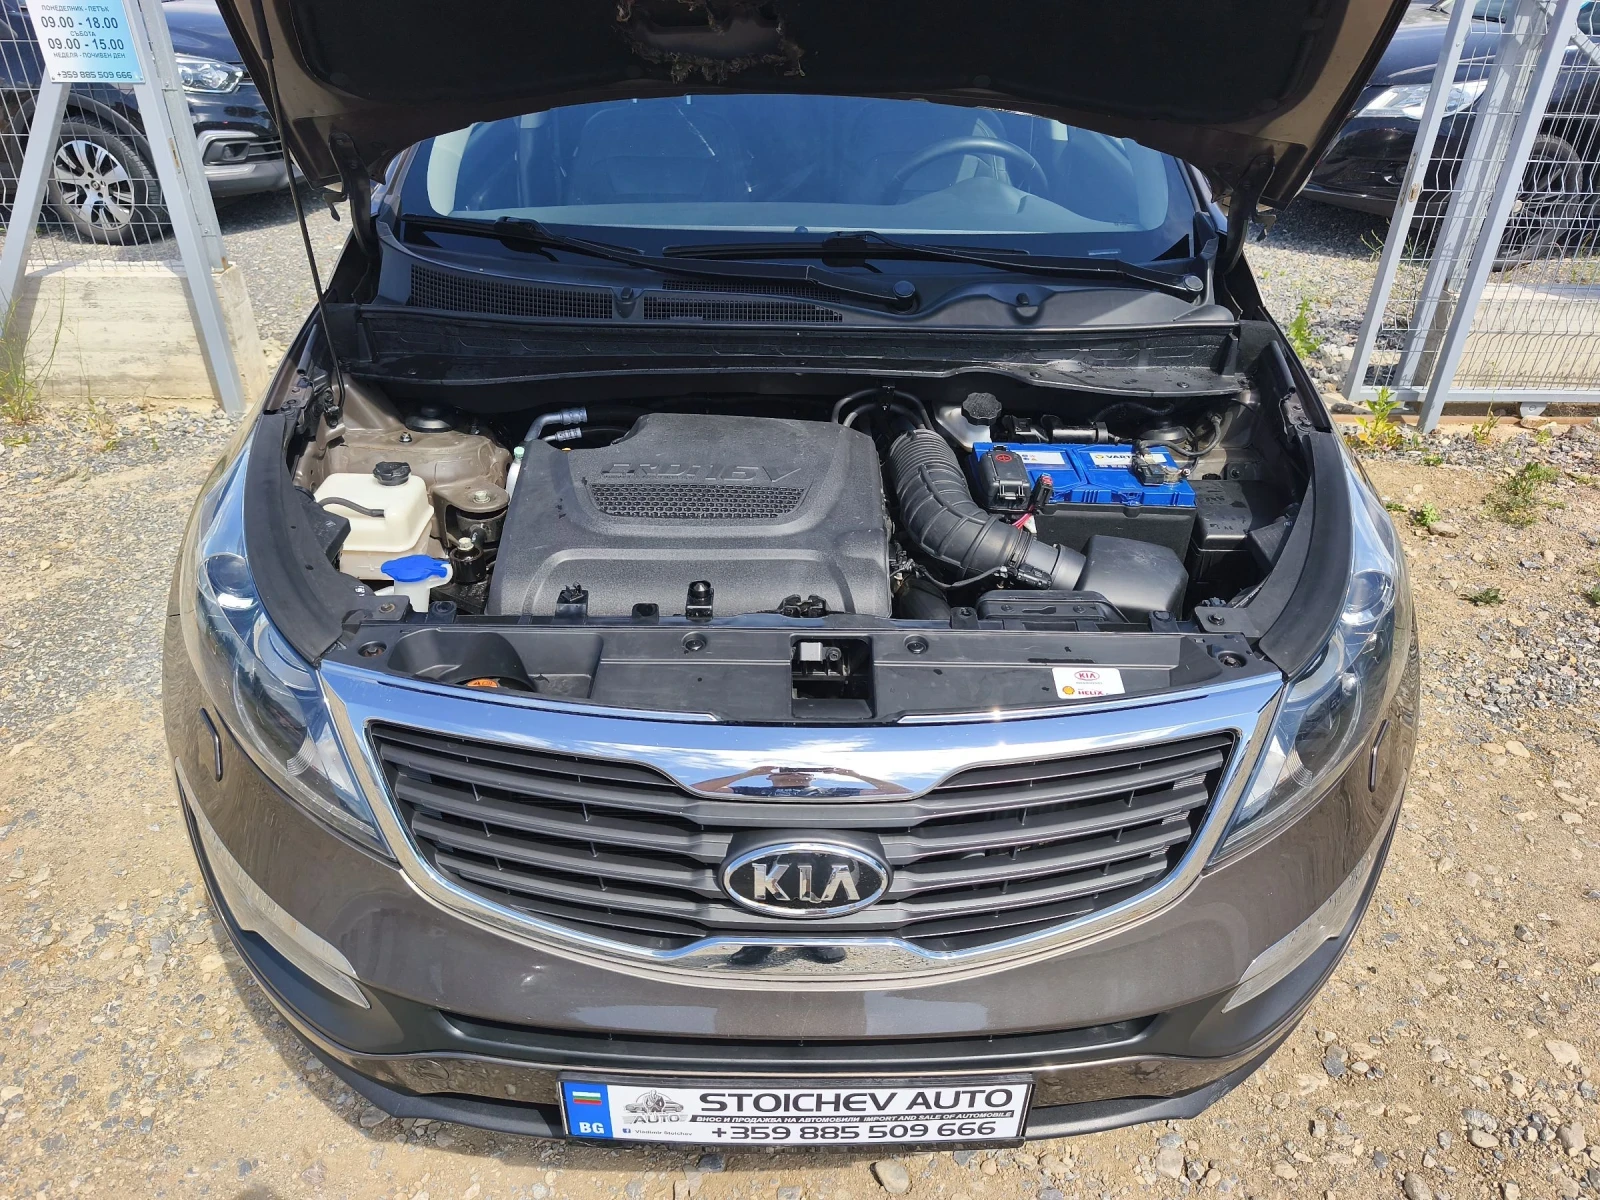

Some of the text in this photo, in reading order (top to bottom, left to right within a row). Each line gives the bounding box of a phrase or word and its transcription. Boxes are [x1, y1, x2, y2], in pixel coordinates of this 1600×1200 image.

[41, 16, 74, 28] 09.00
[86, 17, 119, 29] 18.00
[47, 38, 81, 50] 09.00
[92, 38, 125, 50] 15.00
[113, 52, 126, 60] ДЕН
[56, 70, 133, 80] +359 885 509 666
[751, 862, 861, 902] KIA
[699, 1088, 1013, 1112] STOICHEV AUTO
[633, 1114, 680, 1124] AUTO
[732, 1116, 783, 1124] ПРОДАЖБА
[918, 1113, 941, 1121] SALE
[956, 1111, 1012, 1119] AUTOMOBILE
[579, 1121, 605, 1135] BG
[712, 1121, 996, 1140] +359 885 509 666
